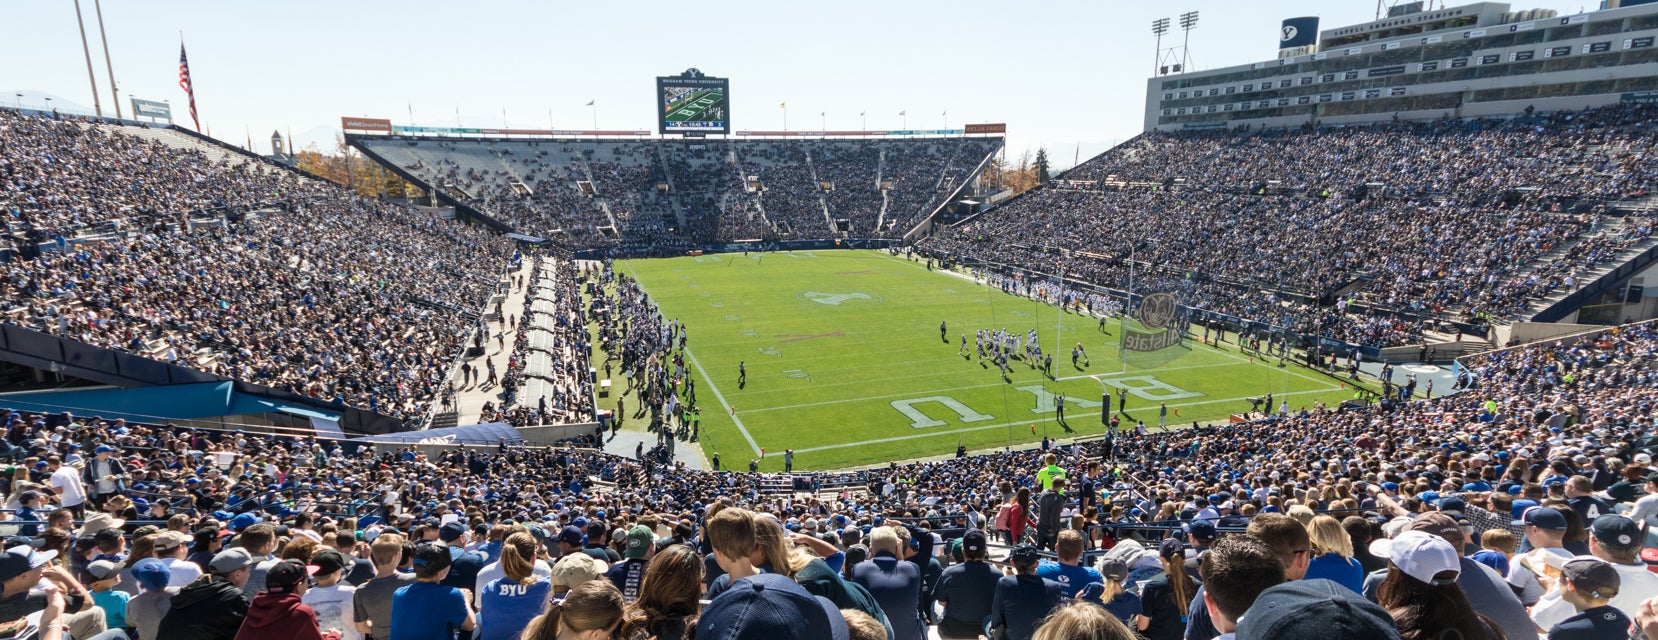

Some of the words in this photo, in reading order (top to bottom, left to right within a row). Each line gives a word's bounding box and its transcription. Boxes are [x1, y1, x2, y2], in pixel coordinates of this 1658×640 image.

[1417, 10, 1463, 22] STADIUM
[1283, 27, 1294, 39] Y
[688, 69, 698, 77] Y
[1586, 504, 1600, 519] 4
[499, 584, 527, 597] BYU
